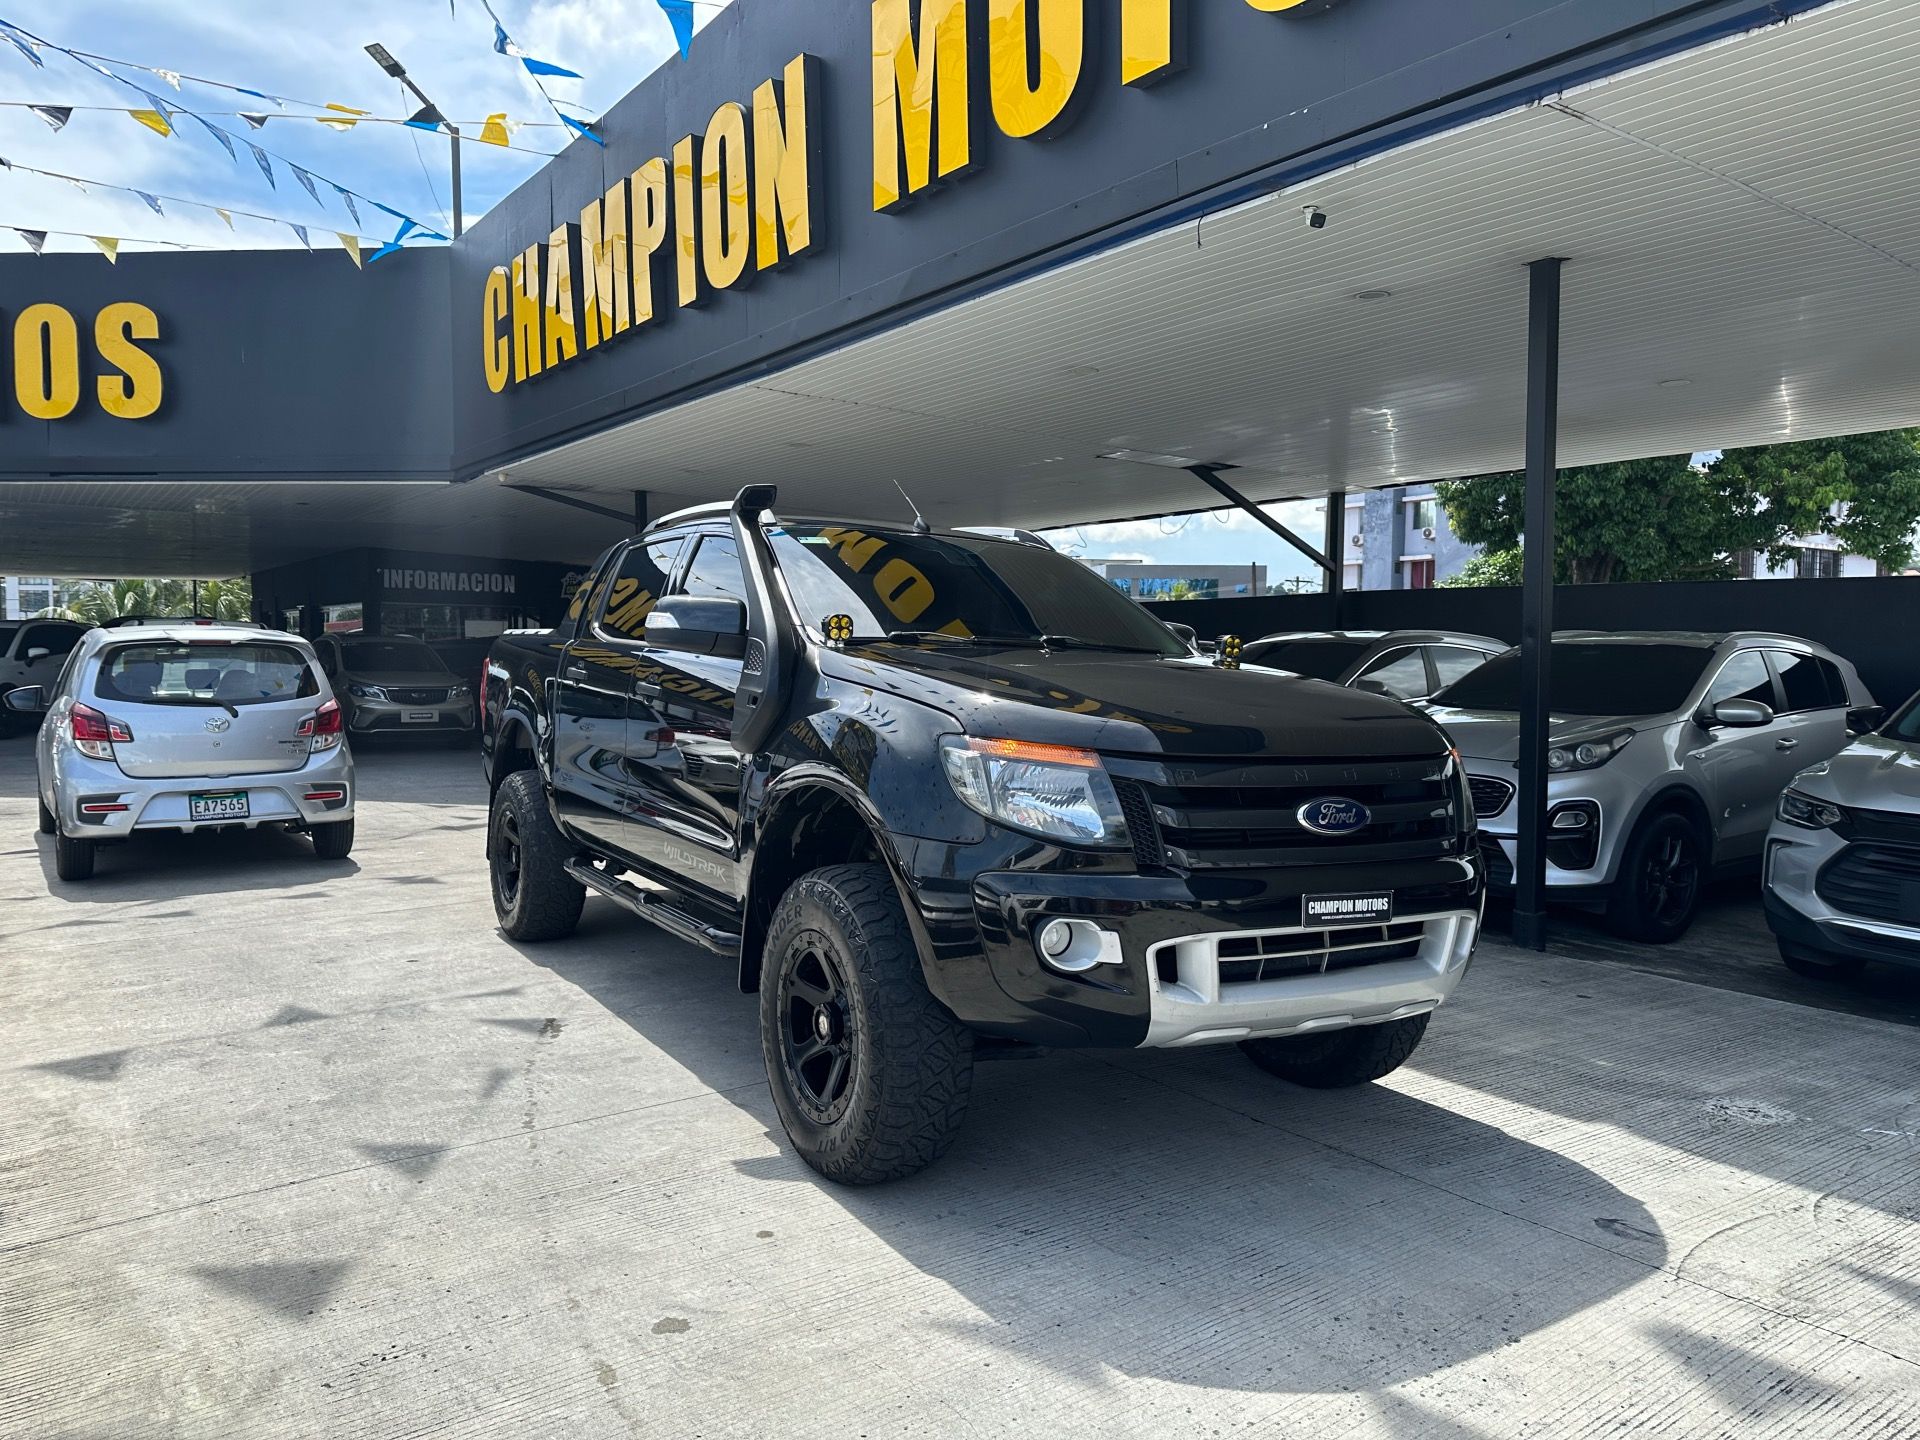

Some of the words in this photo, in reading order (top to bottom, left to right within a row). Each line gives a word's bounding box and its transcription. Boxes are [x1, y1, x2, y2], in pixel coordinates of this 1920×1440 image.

[484, 53, 812, 393] CHAMPION
[873, 0, 1328, 213] MO
[383, 568, 516, 593] INFORMACION
[195, 799, 244, 813] EA7565
[1318, 803, 1357, 826] Ford
[663, 841, 727, 883] WILDTRAK
[1308, 900, 1354, 914] CHAMPION
[1355, 898, 1388, 911] MOTORS
